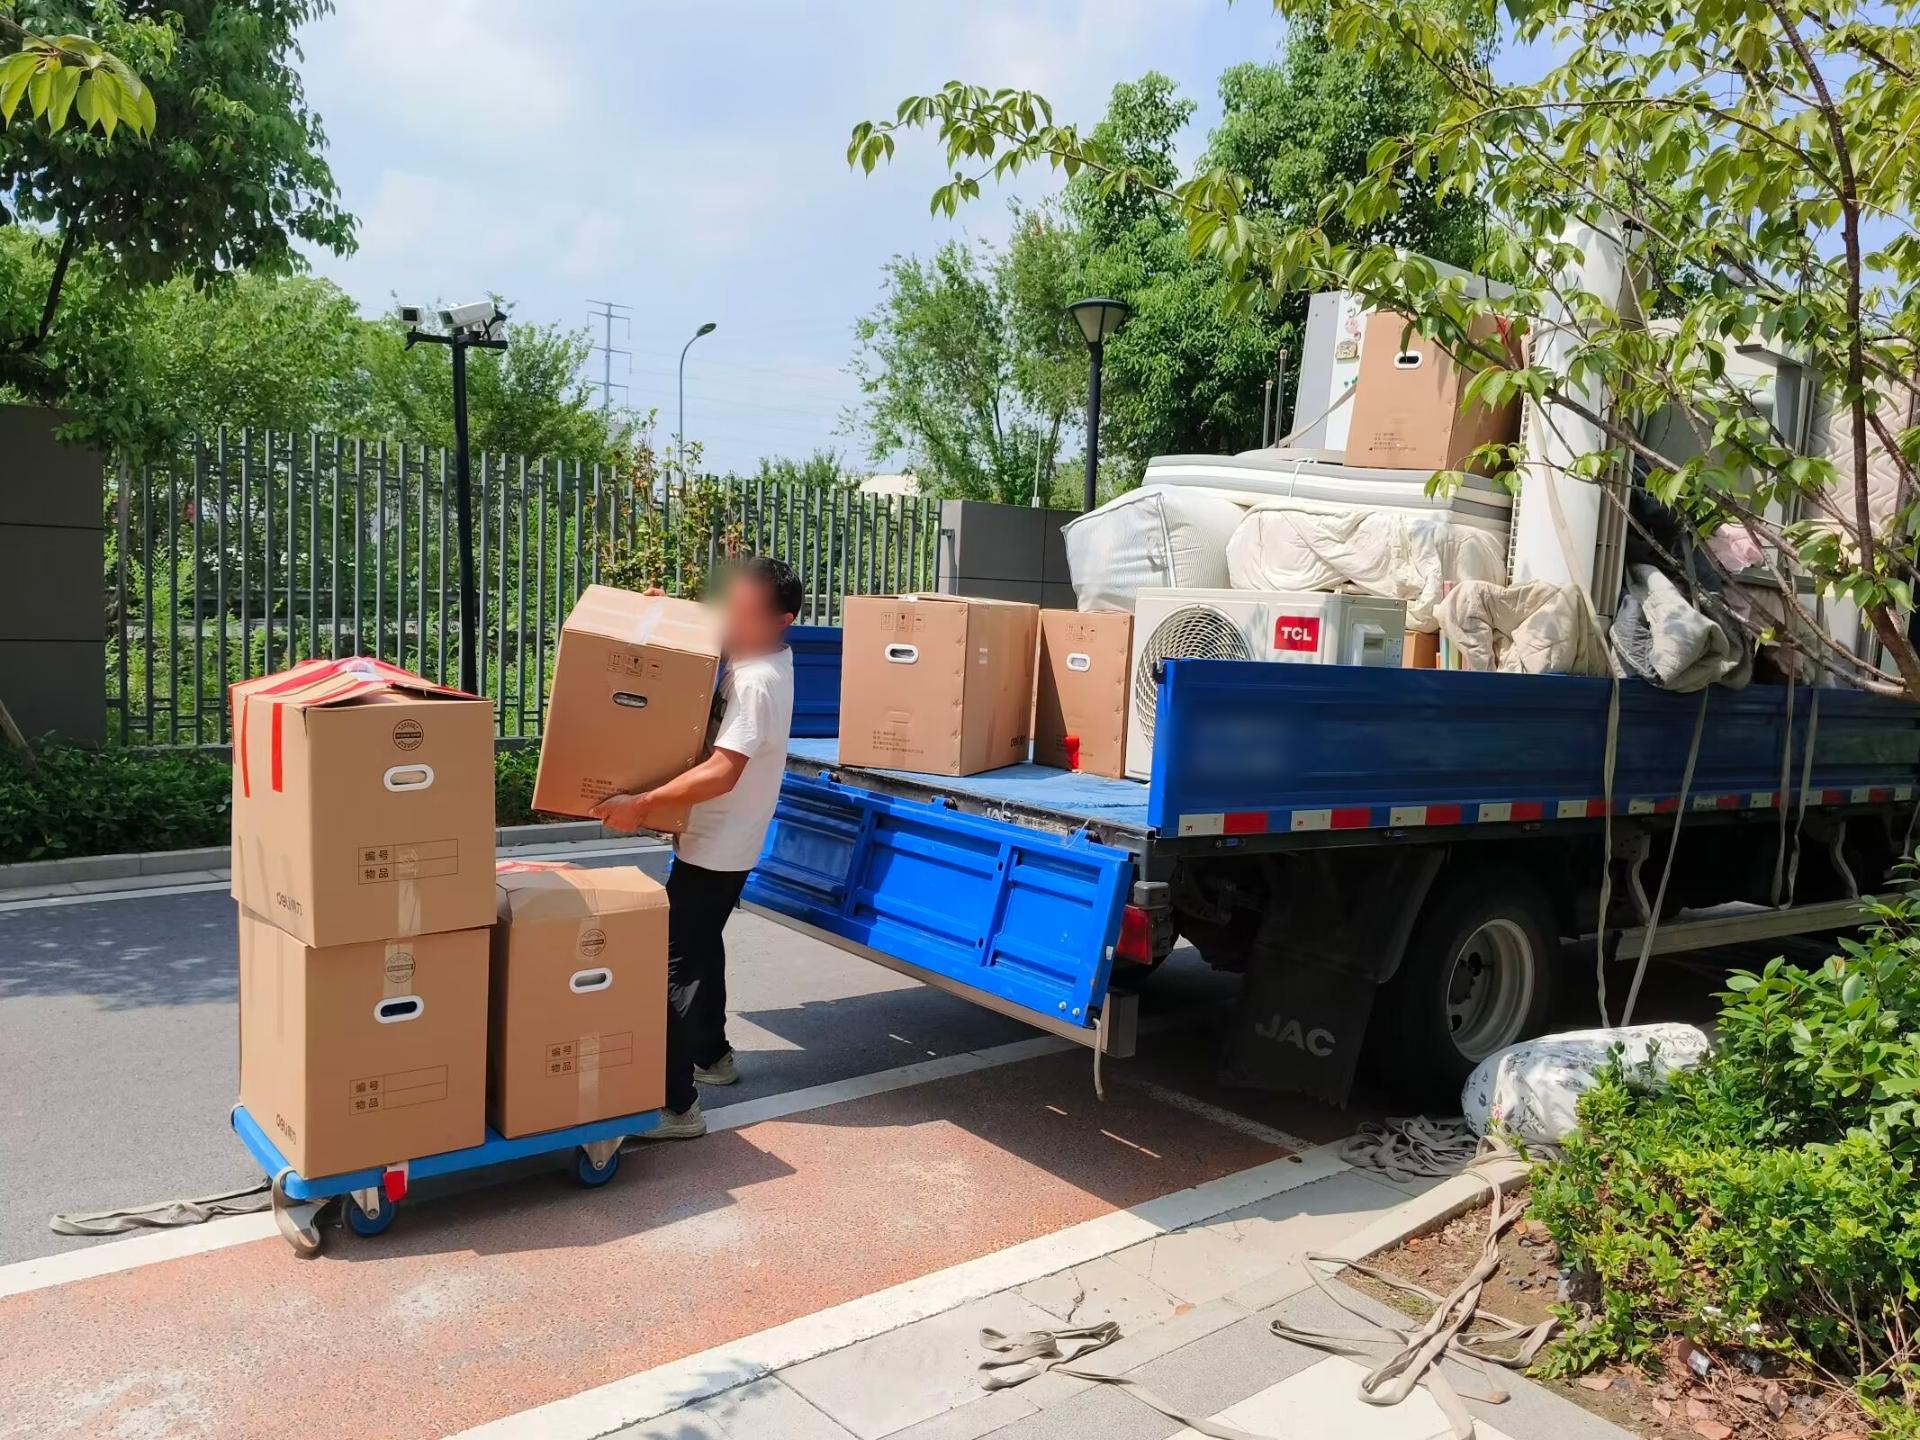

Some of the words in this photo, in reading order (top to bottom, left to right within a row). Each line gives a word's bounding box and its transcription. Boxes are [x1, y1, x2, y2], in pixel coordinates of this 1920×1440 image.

[1281, 627, 1312, 641] TCL
[983, 807, 1012, 823] JAC
[365, 849, 388, 861] 编号
[365, 867, 388, 880] 物品
[1256, 1014, 1336, 1057] JAC
